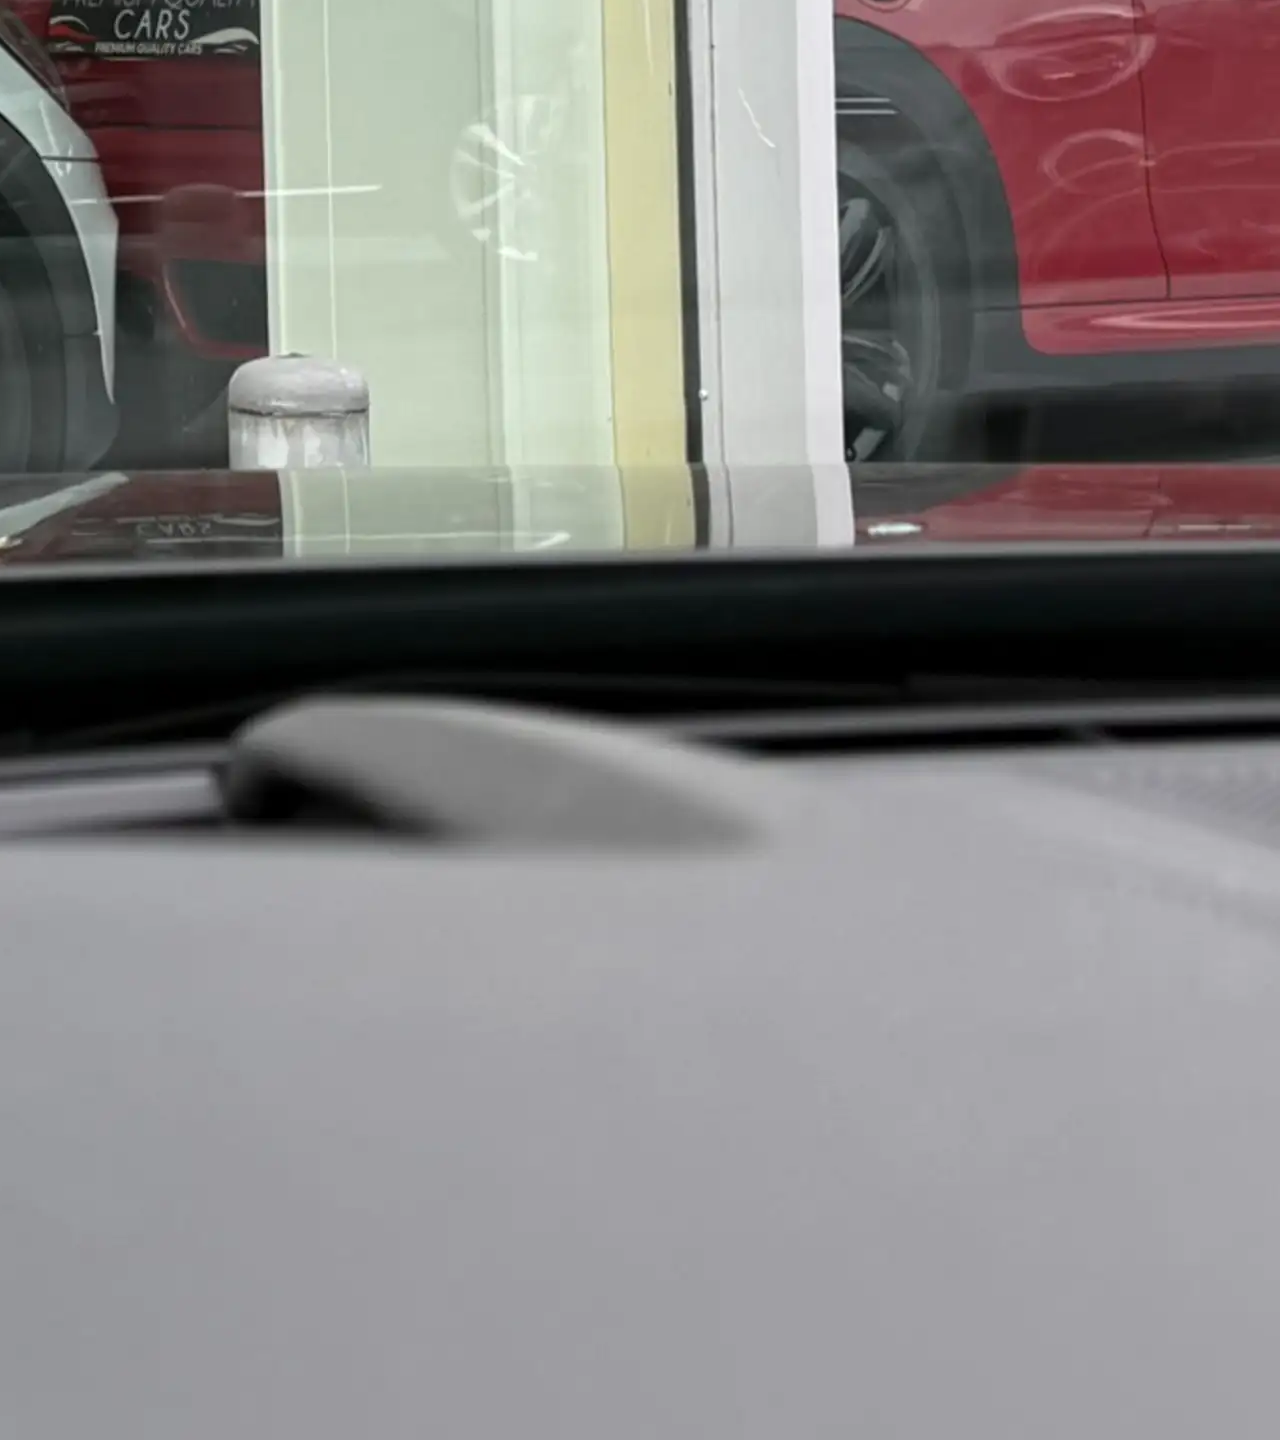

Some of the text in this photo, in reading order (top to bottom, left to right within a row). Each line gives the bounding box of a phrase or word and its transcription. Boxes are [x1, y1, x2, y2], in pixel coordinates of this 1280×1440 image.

[113, 9, 191, 41] CARS
[94, 41, 203, 56] PREMIUM QUALITY CARS
